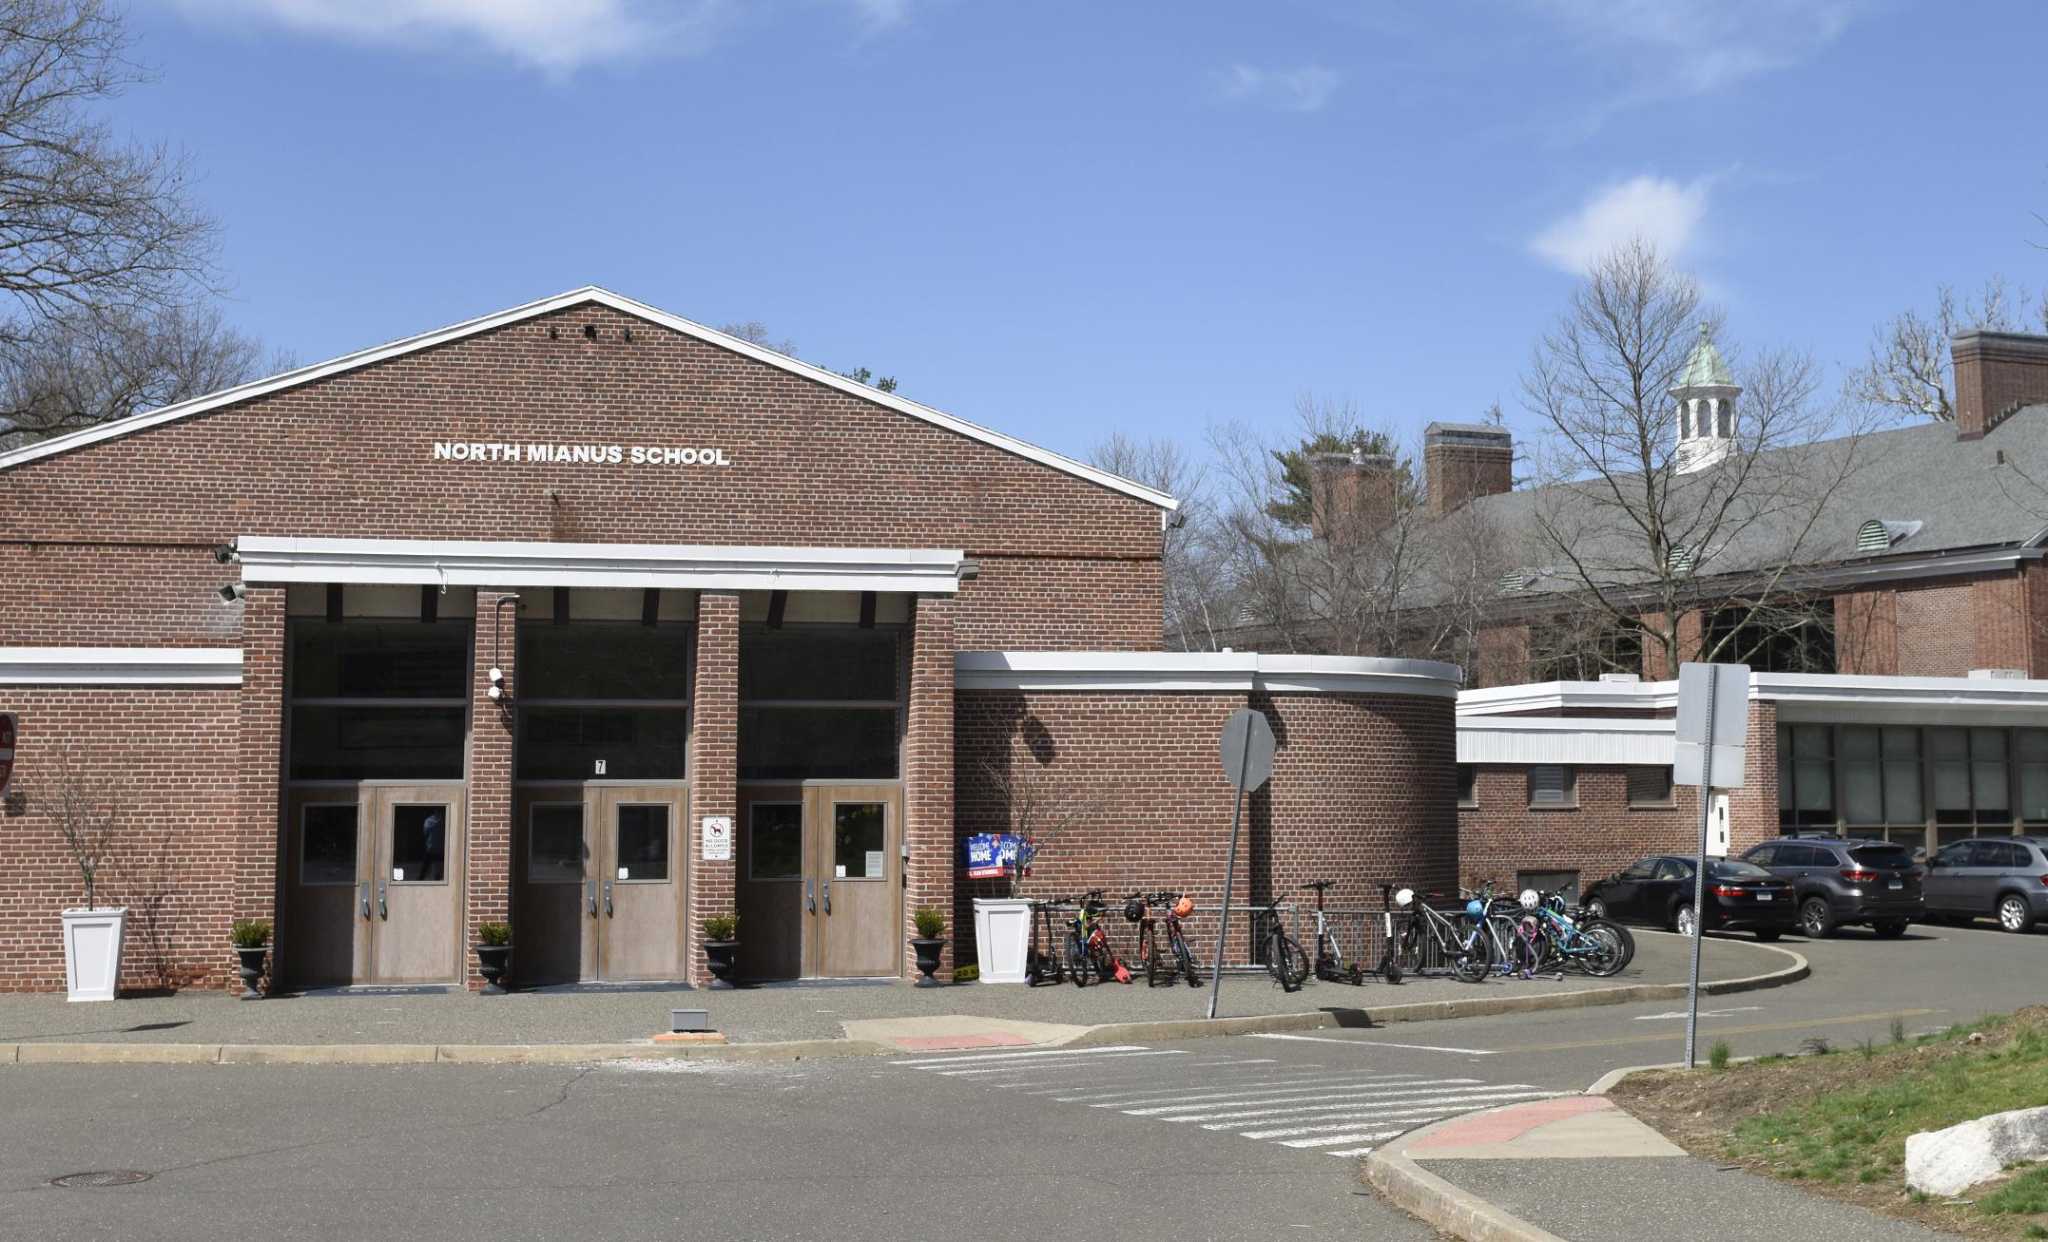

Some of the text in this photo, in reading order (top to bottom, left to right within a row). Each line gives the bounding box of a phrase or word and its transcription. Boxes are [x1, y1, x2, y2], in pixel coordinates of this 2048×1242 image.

[433, 442, 731, 466] NORTH MIANUS SCHOOL
[971, 850, 992, 862] HOME
[1000, 849, 1016, 860] OME
